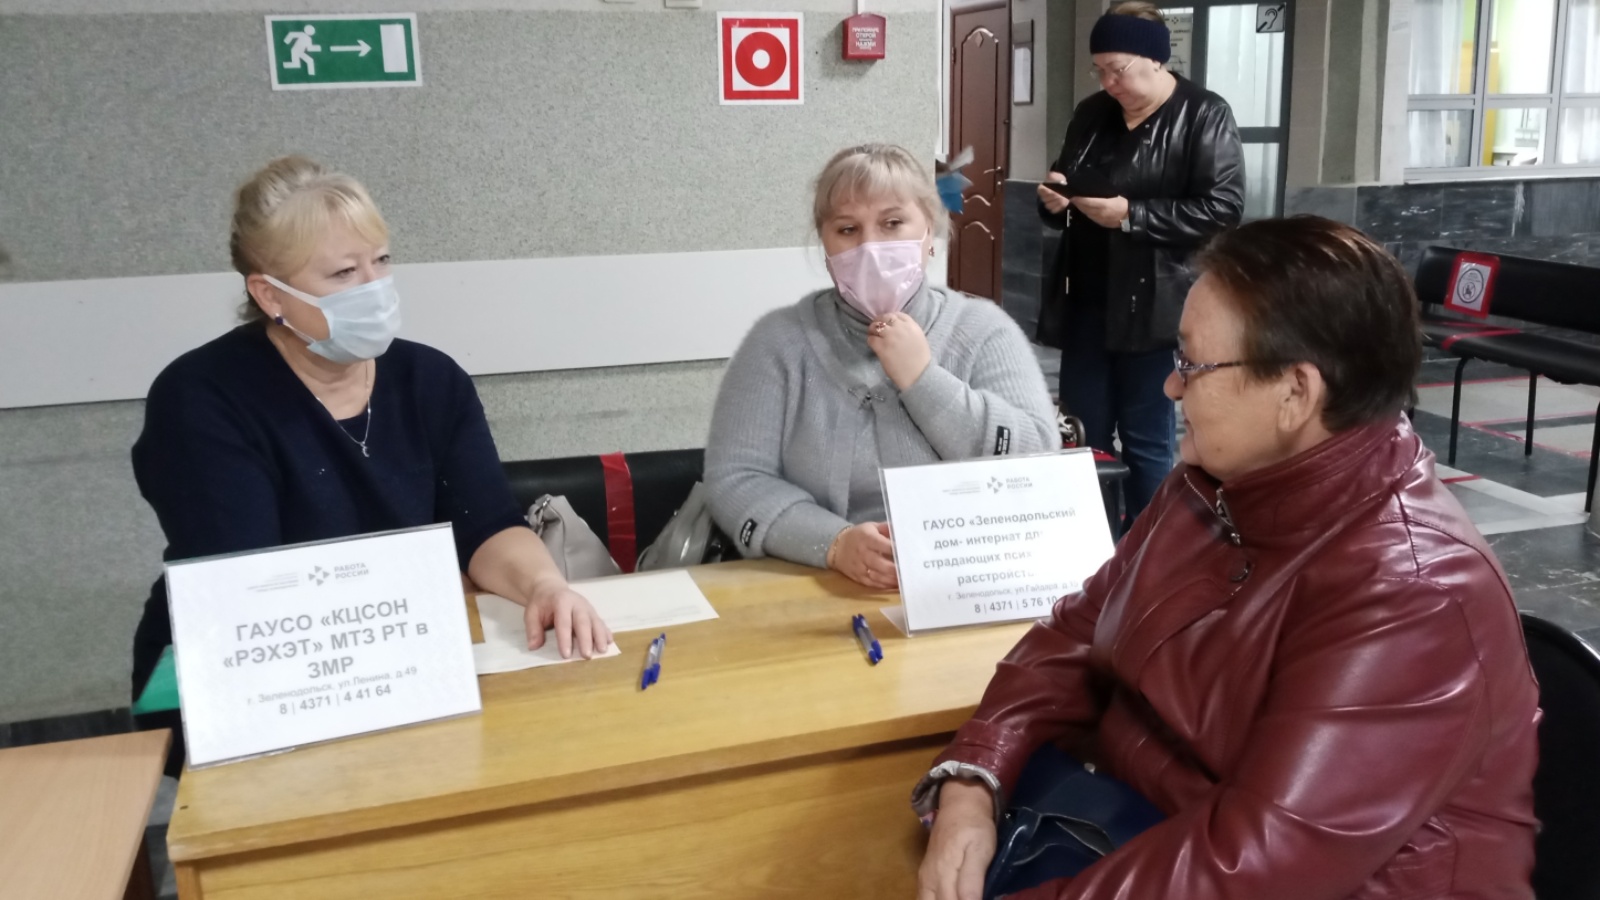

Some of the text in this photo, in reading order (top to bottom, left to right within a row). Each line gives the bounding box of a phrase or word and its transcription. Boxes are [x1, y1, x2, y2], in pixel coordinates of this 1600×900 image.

[922, 507, 1077, 531] ГАУСО «Зеленодольский
[933, 538, 963, 550] дом-
[966, 531, 1021, 546] интернат
[333, 562, 367, 573] РАБОТА
[922, 553, 1001, 570] страдающих
[334, 569, 370, 580] РОССИИ
[974, 603, 981, 614] 8
[989, 600, 1013, 612] 4371
[1022, 597, 1029, 609] 5
[1031, 596, 1044, 607] 76
[235, 598, 409, 642] ГАУСО «КЦСОН
[222, 638, 324, 669] «РЭХЭТ»
[381, 621, 409, 642] РТ
[415, 622, 430, 637] в
[279, 702, 288, 715] 8
[299, 694, 332, 711] 4371
[343, 690, 352, 702] 4
[355, 687, 371, 700] 41
[375, 683, 392, 698] 64
